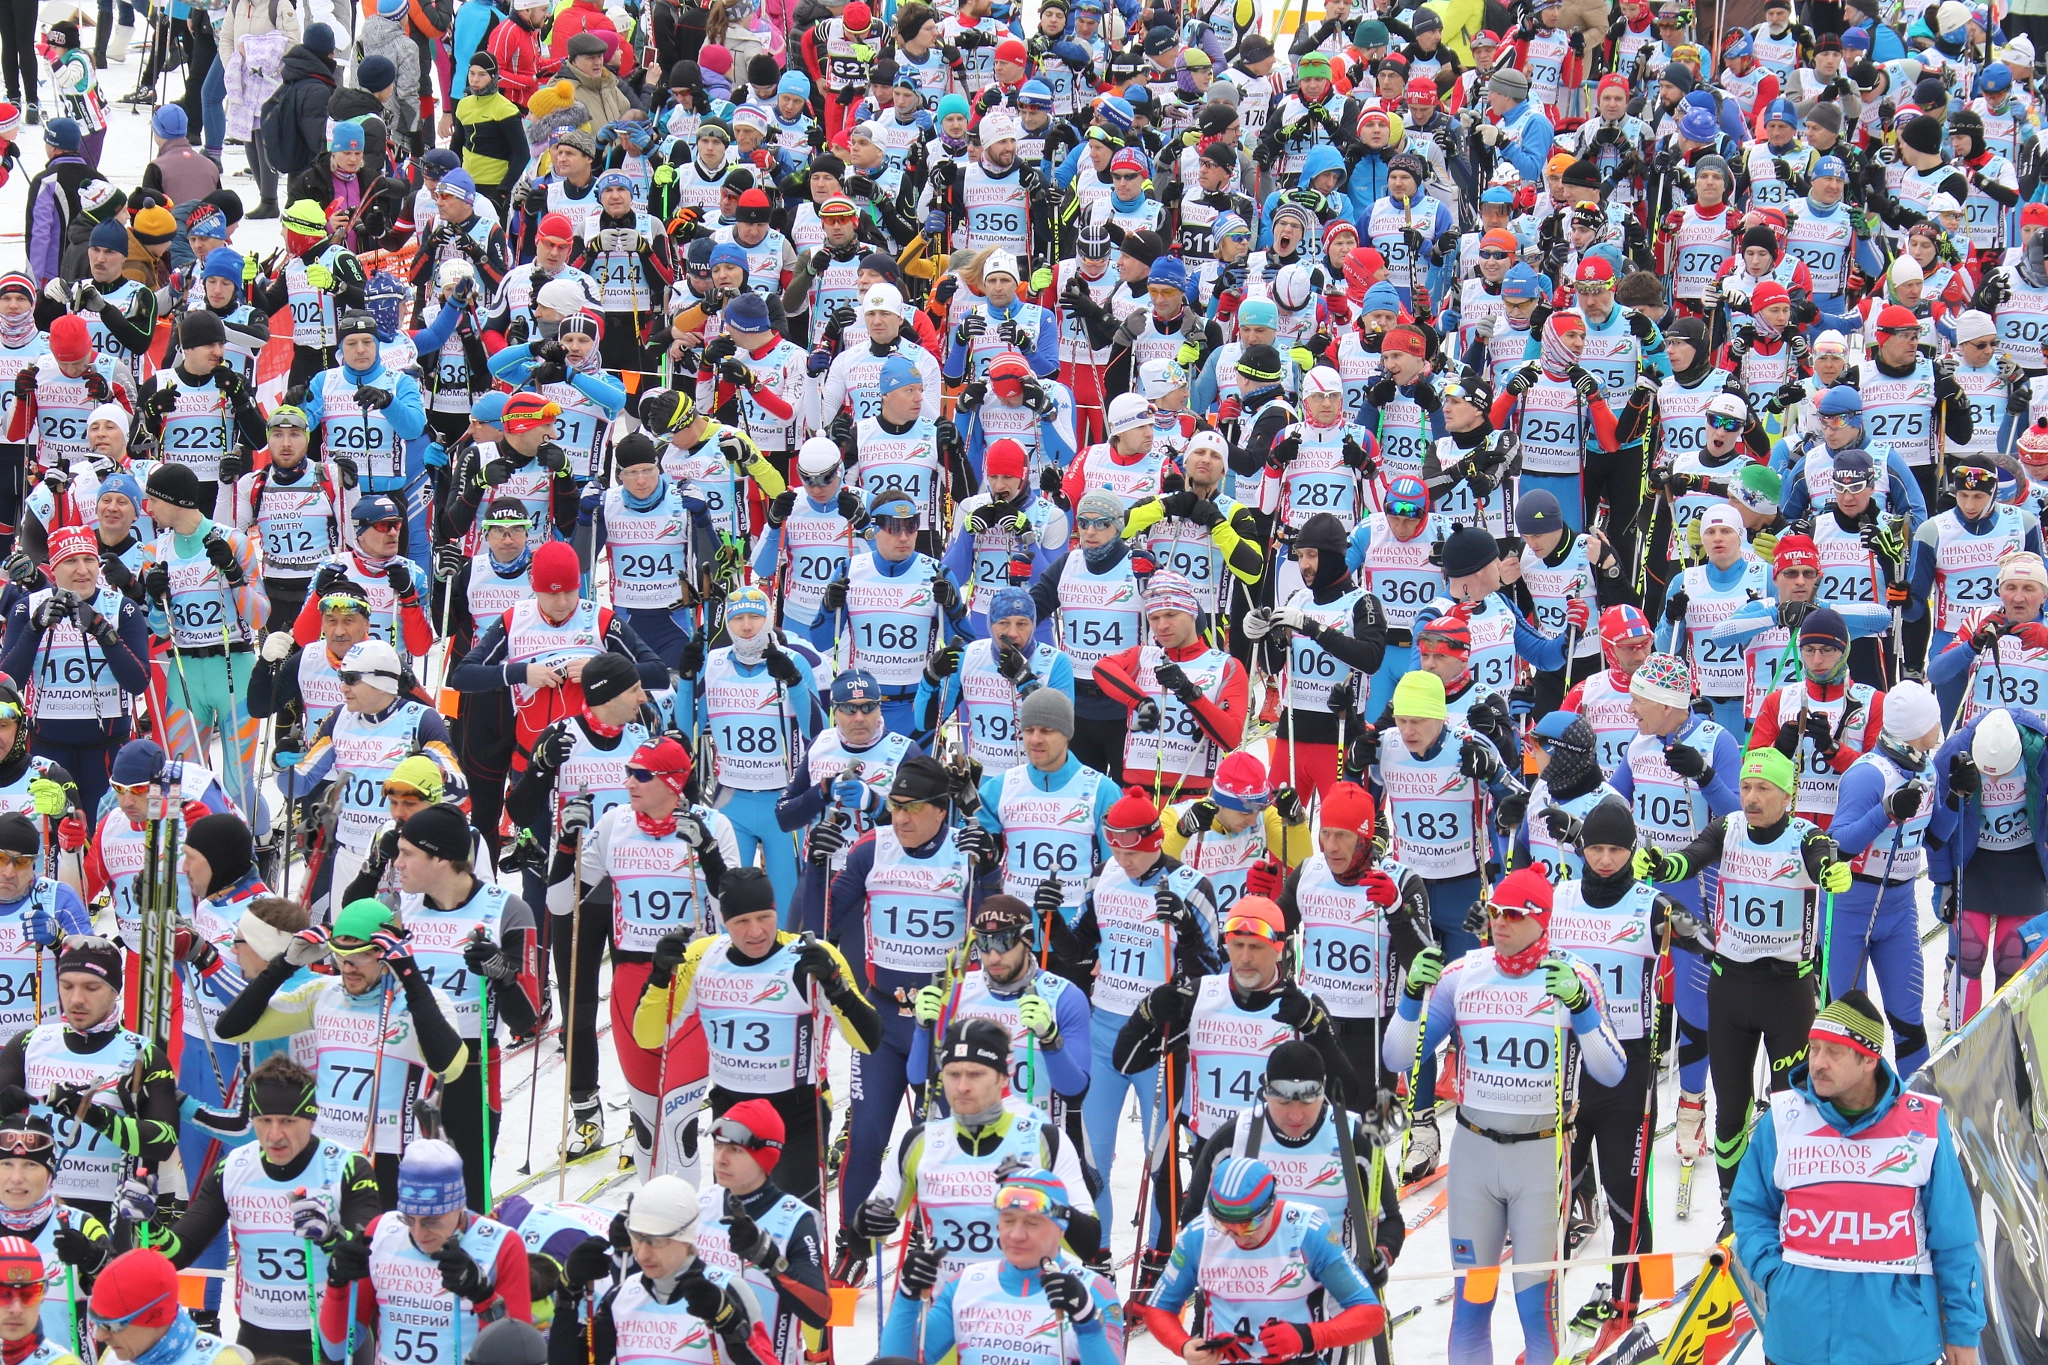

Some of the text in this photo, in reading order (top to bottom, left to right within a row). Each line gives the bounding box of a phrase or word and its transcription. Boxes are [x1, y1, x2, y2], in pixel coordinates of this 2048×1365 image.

[1244, 110, 1264, 126] 176
[682, 196, 717, 204] ПЕРЕВОЗ
[966, 194, 1004, 202] ПЕРЕВОЗ
[1758, 186, 1798, 202] 435
[976, 213, 1018, 231] 356
[690, 262, 710, 270] VITAL
[1684, 252, 1723, 272] 378
[1792, 248, 1836, 270] 320
[596, 265, 642, 284] 344
[290, 302, 321, 324] 202
[1862, 382, 1908, 394] НИКОЛОВ
[1862, 391, 1904, 402] ПЕРЕВОЗ
[982, 412, 1026, 421] НИКОЛОВ
[983, 420, 1022, 430] ПЕРЕВОЗ
[1527, 418, 1575, 444] 254
[1870, 414, 1922, 436] 275
[172, 426, 222, 448] 223
[334, 426, 383, 448] 269
[1669, 427, 1706, 448] 260
[860, 443, 906, 452] НИКОЛОВ
[1387, 436, 1428, 456] 289
[1524, 445, 1575, 457] ТАЛДОМски
[859, 451, 903, 461] ПЕРЕВОЗ
[1288, 459, 1330, 470] ПЕРЕВОЗ
[1085, 471, 1130, 483] НИКОЛОВ
[1836, 470, 1859, 478] VITAL
[870, 474, 920, 498] 284
[1297, 483, 1346, 506] 287
[270, 512, 302, 520] IVANOV
[492, 508, 518, 519] VITAL
[270, 522, 303, 530] DMITRY
[607, 520, 656, 530] НИКОЛОВ
[787, 521, 836, 532] НИКОЛОВ
[58, 536, 88, 549] VITAL
[268, 531, 314, 554] 312
[609, 530, 654, 540] ПЕРЕВОЗ
[788, 531, 833, 540] ПЕРЕВОЗ
[1372, 548, 1422, 556] НИКОЛОВ
[1784, 550, 1807, 560] VITAL
[1817, 551, 1860, 560] ПЕРЕВОЗ
[1942, 542, 1994, 556] НИКОЛОВ
[621, 552, 674, 578] 294
[1372, 556, 1419, 566] ПЕРЕВОЗ
[1942, 553, 1992, 565] ПЕРЕВОЗ
[623, 582, 679, 592] ТАЛДОМски
[850, 586, 904, 598] НИКОЛОВ
[1059, 583, 1107, 594] НИКОЛОВ
[1382, 578, 1436, 604] 360
[1824, 576, 1874, 600] 242
[471, 590, 520, 600] НИКОЛОВ
[850, 596, 899, 607] ПЕРЕВОЗ
[1059, 593, 1104, 604] ПЕРЕВОЗ
[472, 599, 516, 609] ПЕРЕВОЗ
[732, 601, 765, 612] RUSSIA
[1686, 602, 1737, 613] НИКОЛОВ
[514, 635, 567, 646] НИКОЛОВ
[861, 623, 918, 650] 168
[1068, 620, 1123, 647] 154
[860, 654, 918, 664] ТАЛДОМски
[46, 658, 108, 684] 167
[1471, 655, 1513, 684] 131
[707, 686, 760, 698] НИКОЛОВ
[848, 680, 869, 689] DNB
[1983, 677, 2039, 705] 133
[964, 686, 1010, 699] ПЕРЕВОЗ
[708, 697, 756, 708] ПЕРЕВОЗ
[332, 739, 382, 751] НИКОЛОВ
[723, 725, 777, 754] 188
[1548, 738, 1566, 748] ONE
[564, 761, 623, 775] НИКОЛОВ
[725, 769, 774, 780] russialoppet
[1632, 764, 1673, 778] ПЕРЕВОЗ
[1384, 770, 1438, 783] НИКОЛОВ
[1387, 781, 1434, 794] ПЕРЕВОЗ
[1003, 800, 1060, 812] НИКОЛОВ
[1638, 793, 1690, 828] 105
[1402, 810, 1458, 840] 183
[613, 846, 674, 858] НИКОЛОВ
[1016, 840, 1078, 872] 166
[1406, 842, 1463, 856] ТАЛДОМски
[614, 858, 671, 870] ПЕРЕВОЗ
[628, 889, 693, 920] 197
[1302, 894, 1356, 909] НИКОЛОВ
[975, 910, 1012, 924] VITAL
[1096, 904, 1142, 920] ПЕРЕВОЗ
[1303, 907, 1351, 921] ПЕРЕВОЗ
[1729, 894, 1785, 928] 161
[884, 907, 954, 939] 155
[1105, 918, 1160, 937] ТРОФИМОВ
[1550, 916, 1612, 931] НИКОЛОВ
[1108, 932, 1152, 949] АЛЕКСЕЙ
[1550, 928, 1607, 943] ПЕРЕВОЗ
[1729, 926, 1792, 944] ТАЛДОМски
[1110, 946, 1146, 977] 111
[1313, 938, 1371, 974] 186
[1460, 990, 1528, 1002] НИКОЛОВ
[1459, 1001, 1523, 1016] ПЕРЕВОЗ
[317, 1015, 376, 1031] НИКОЛОВ
[1198, 1018, 1262, 1036] НИКОЛОВ
[318, 1028, 368, 1045] ПЕРЕВОЗ
[709, 1019, 770, 1052] 113
[1196, 1032, 1258, 1048] ПЕРЕВОЗ
[798, 1025, 808, 1071] salomon
[1472, 1035, 1550, 1070] 140
[27, 1064, 95, 1080] НИКОЛОВ
[1565, 1042, 1576, 1090] salomon
[850, 1048, 864, 1100] SATURN
[1472, 1071, 1551, 1088] ТАЛДОМски
[330, 1065, 376, 1101] 77
[1477, 1088, 1542, 1103] russialoppet
[404, 1081, 416, 1132] salomon
[7, 1131, 34, 1144] DNB
[1788, 1143, 1872, 1161] НИКОЛОВ
[1788, 1159, 1866, 1178] ПЕРЕВОЗ
[926, 1182, 992, 1198] ПЕРЕВОЗ
[1786, 1208, 1911, 1246] СУДЬЯ
[257, 1248, 307, 1281] 53
[1201, 1265, 1268, 1279] НИКОЛОВ
[1203, 1278, 1265, 1294] ПЕРЕВОЗ
[388, 1294, 453, 1312] МЕНЬШОВ
[389, 1310, 449, 1328] ВАЛЕРИЙ
[960, 1307, 1032, 1322] НИКОЛОВ
[617, 1320, 678, 1334] НИКОЛОВ
[959, 1321, 1024, 1336] ПЕРЕВОЗ
[394, 1328, 438, 1364] 55
[618, 1333, 671, 1348] ПЕРЕВОЗ
[969, 1336, 1051, 1356] СТАРОВОЙТ
